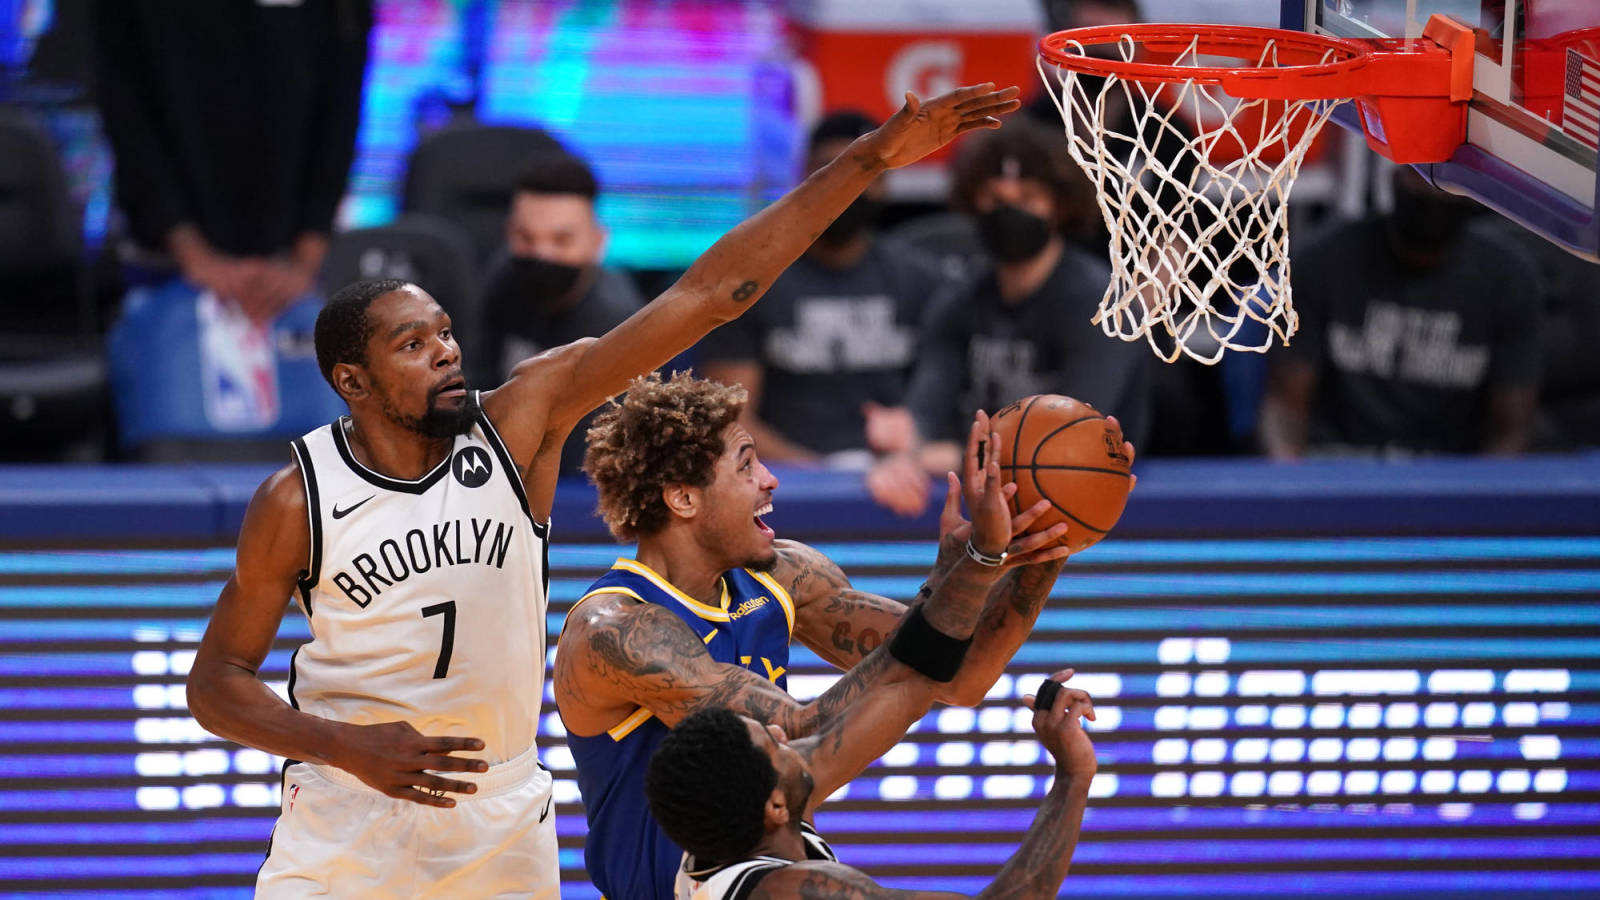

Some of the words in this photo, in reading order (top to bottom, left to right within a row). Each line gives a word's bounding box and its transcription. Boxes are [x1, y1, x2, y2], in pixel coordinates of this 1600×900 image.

[333, 518, 514, 609] BROOKLYN
[421, 600, 456, 679] 7
[729, 596, 769, 620] Rakuten
